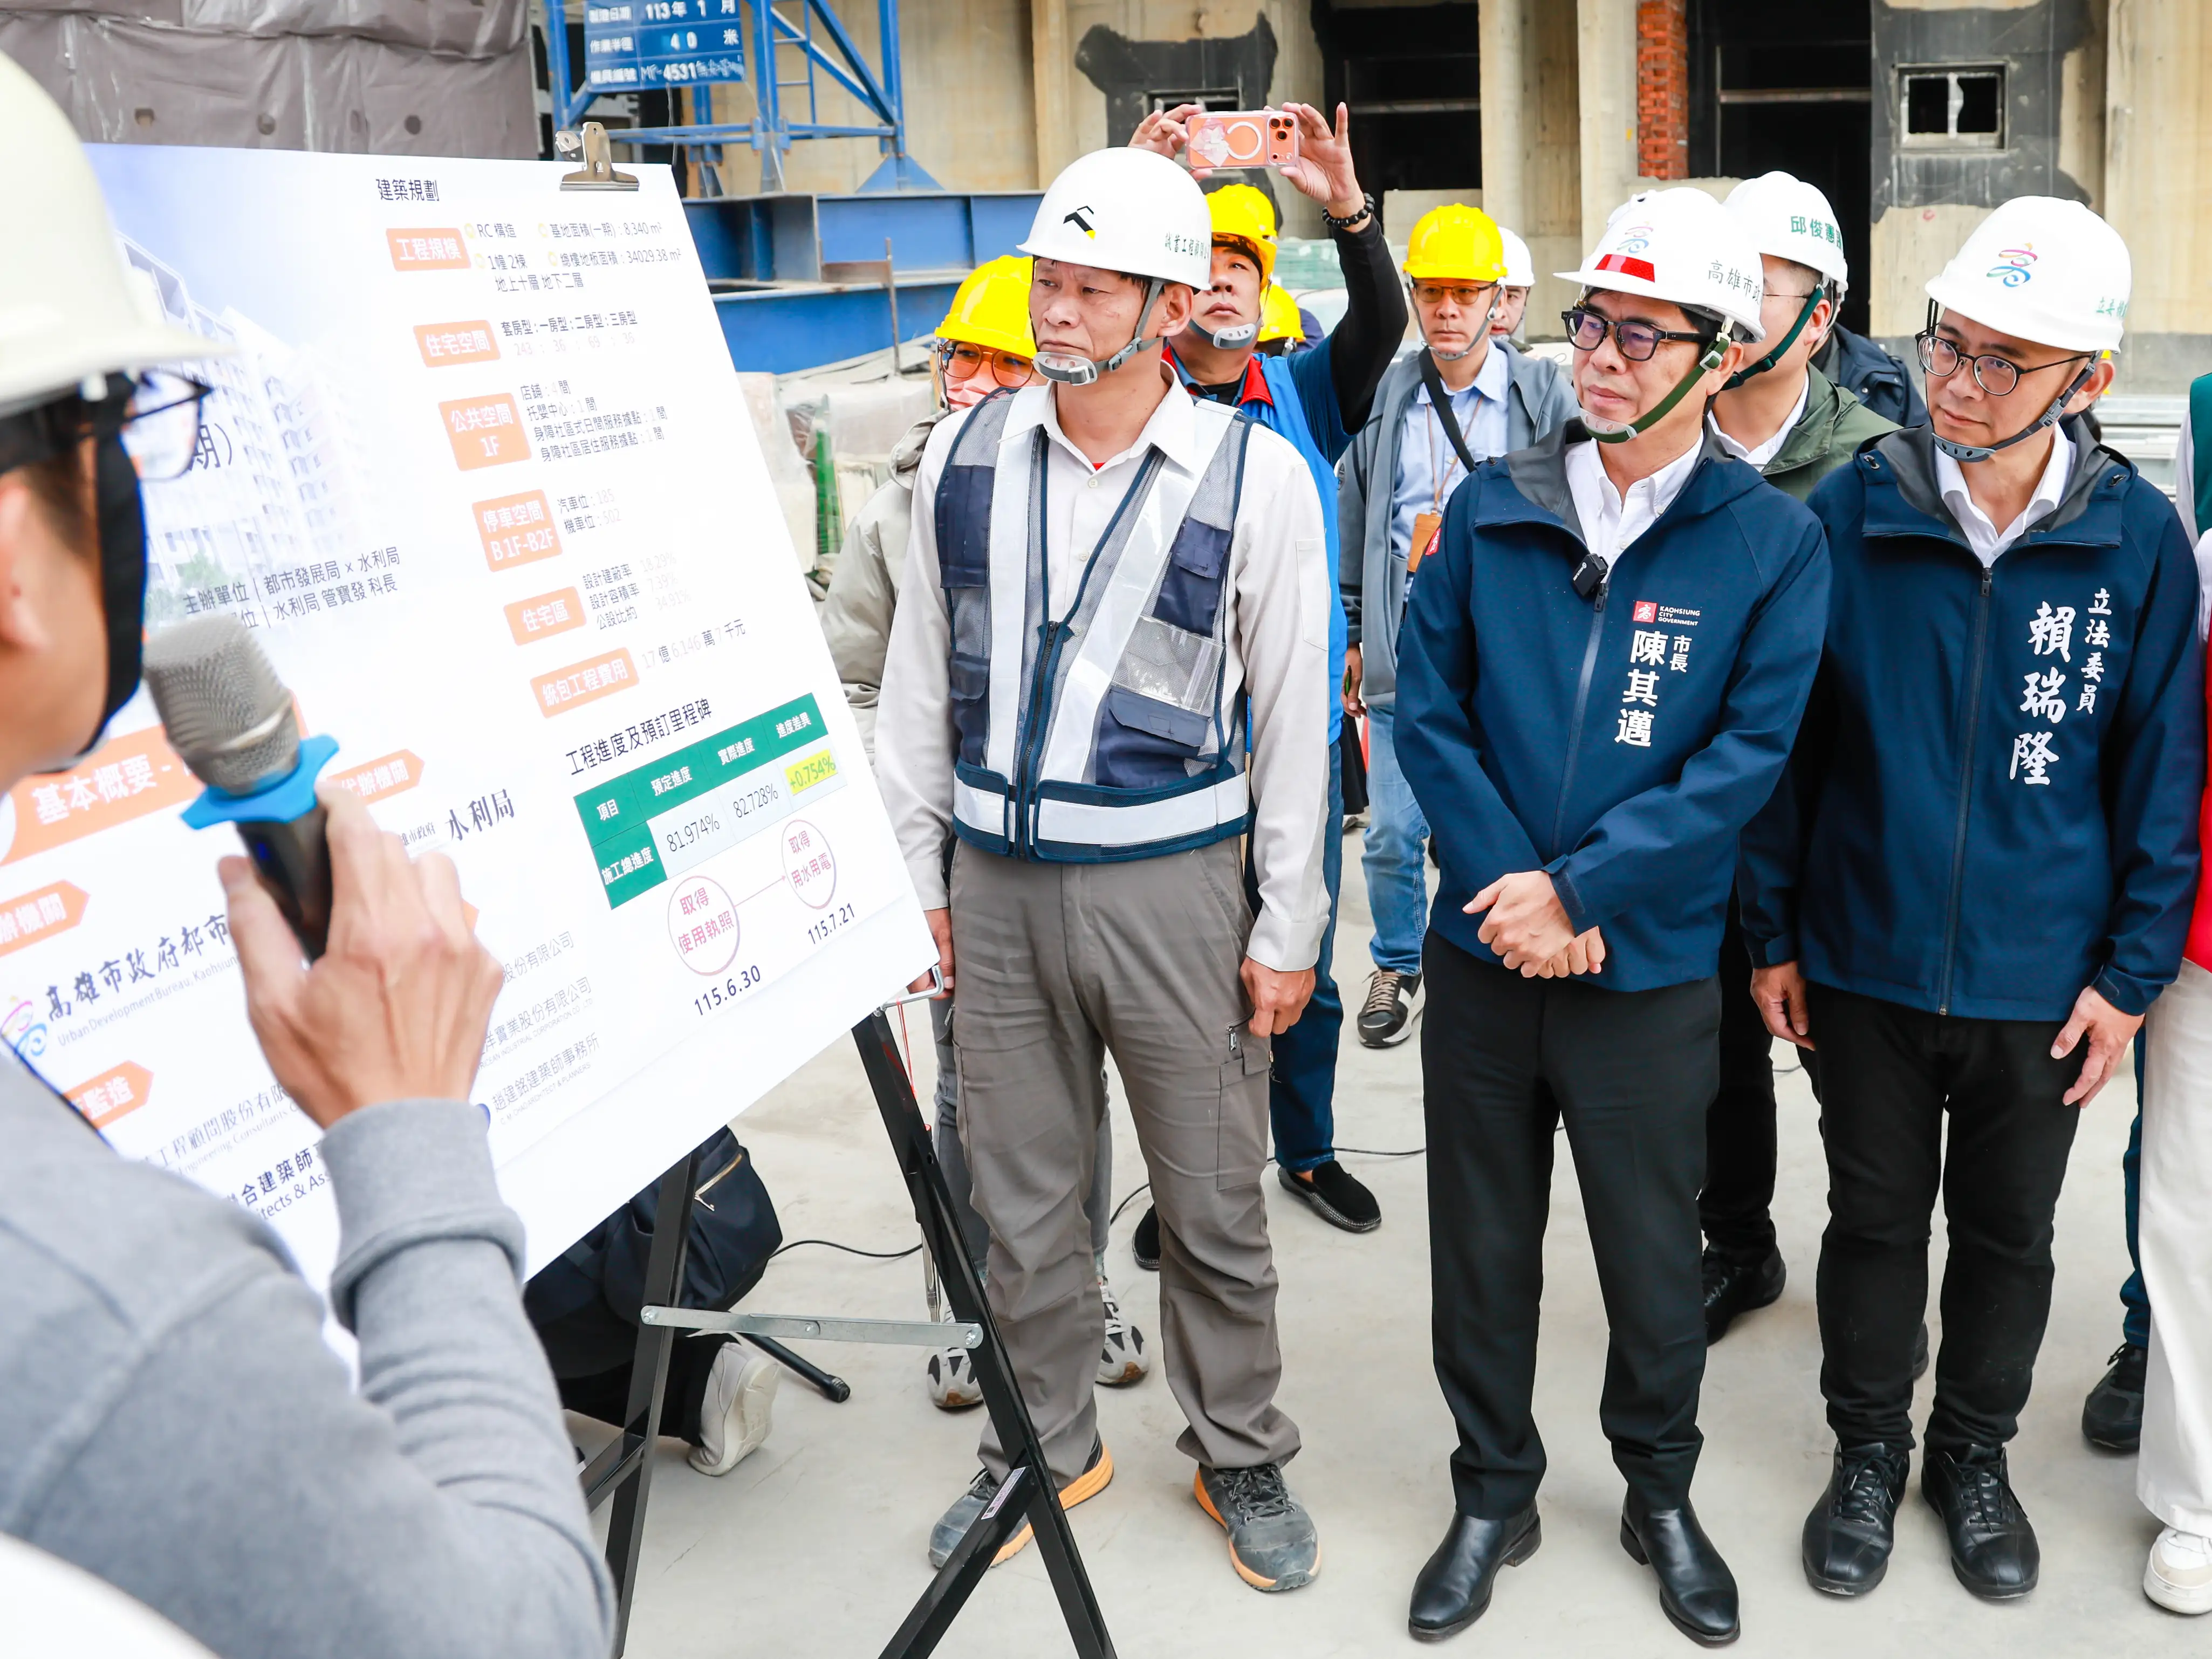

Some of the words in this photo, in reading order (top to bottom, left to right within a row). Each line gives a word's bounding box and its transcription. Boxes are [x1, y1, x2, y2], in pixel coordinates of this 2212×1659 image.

[723, 29, 739, 45] 米
[376, 179, 440, 201] 建築規劃
[477, 224, 493, 237] RC
[494, 223, 517, 238] 構造
[396, 237, 461, 260] 工程規模
[488, 255, 508, 270] 1幢
[511, 253, 528, 270] 2棟
[495, 275, 539, 292] 地上十層
[542, 272, 584, 290] 地下二層
[426, 330, 490, 357] 住宅空間
[450, 403, 513, 432] 公共空間
[481, 436, 500, 457] 1F
[482, 501, 543, 532] 停車空間
[183, 581, 250, 614] 主辦單位
[263, 561, 341, 596] 都市發展局
[358, 546, 400, 572] 水利局
[582, 564, 633, 590] 設計建蔽率
[273, 593, 320, 620] 水利局
[368, 573, 398, 596] 科長
[589, 583, 640, 611] 設計容積率
[1660, 606, 1700, 616] KAOHSIUNG
[523, 600, 569, 632] 住宅區
[597, 606, 637, 630] 公設比約
[1658, 616, 1699, 626] GOVERNMENT
[1670, 635, 1692, 673] 市長
[2076, 588, 2112, 714] 立法委員
[543, 658, 628, 706] 統包工程費用
[1614, 629, 1668, 747] 陳其邁
[2009, 601, 2077, 785] 賴瑞隆
[566, 698, 712, 775] 工程進度及預訂里程碑
[597, 799, 619, 821] 項目
[651, 767, 693, 797] 預定進度
[717, 738, 755, 765] 實際進度
[777, 712, 811, 738] 進度差異
[32, 753, 156, 825] 基本概要
[444, 788, 515, 841] 水利局
[601, 847, 654, 886] 施工總進度
[667, 813, 720, 853] 81.974%
[734, 783, 778, 818] 82.728%
[790, 756, 836, 789] +0.754%
[789, 830, 811, 854] 取得
[791, 853, 831, 888] 用水用電
[680, 887, 709, 915] 取得
[678, 910, 734, 955] 使用執照
[809, 903, 855, 944] 115.7.21
[695, 965, 761, 1016] 115.6.30
[58, 1024, 90, 1047] Urban
[90, 992, 155, 1032] Development
[156, 976, 194, 999] Bureau,
[76, 1076, 134, 1120] 監造
[227, 1139, 321, 1206] 合建築師
[293, 1183, 307, 1199] &
